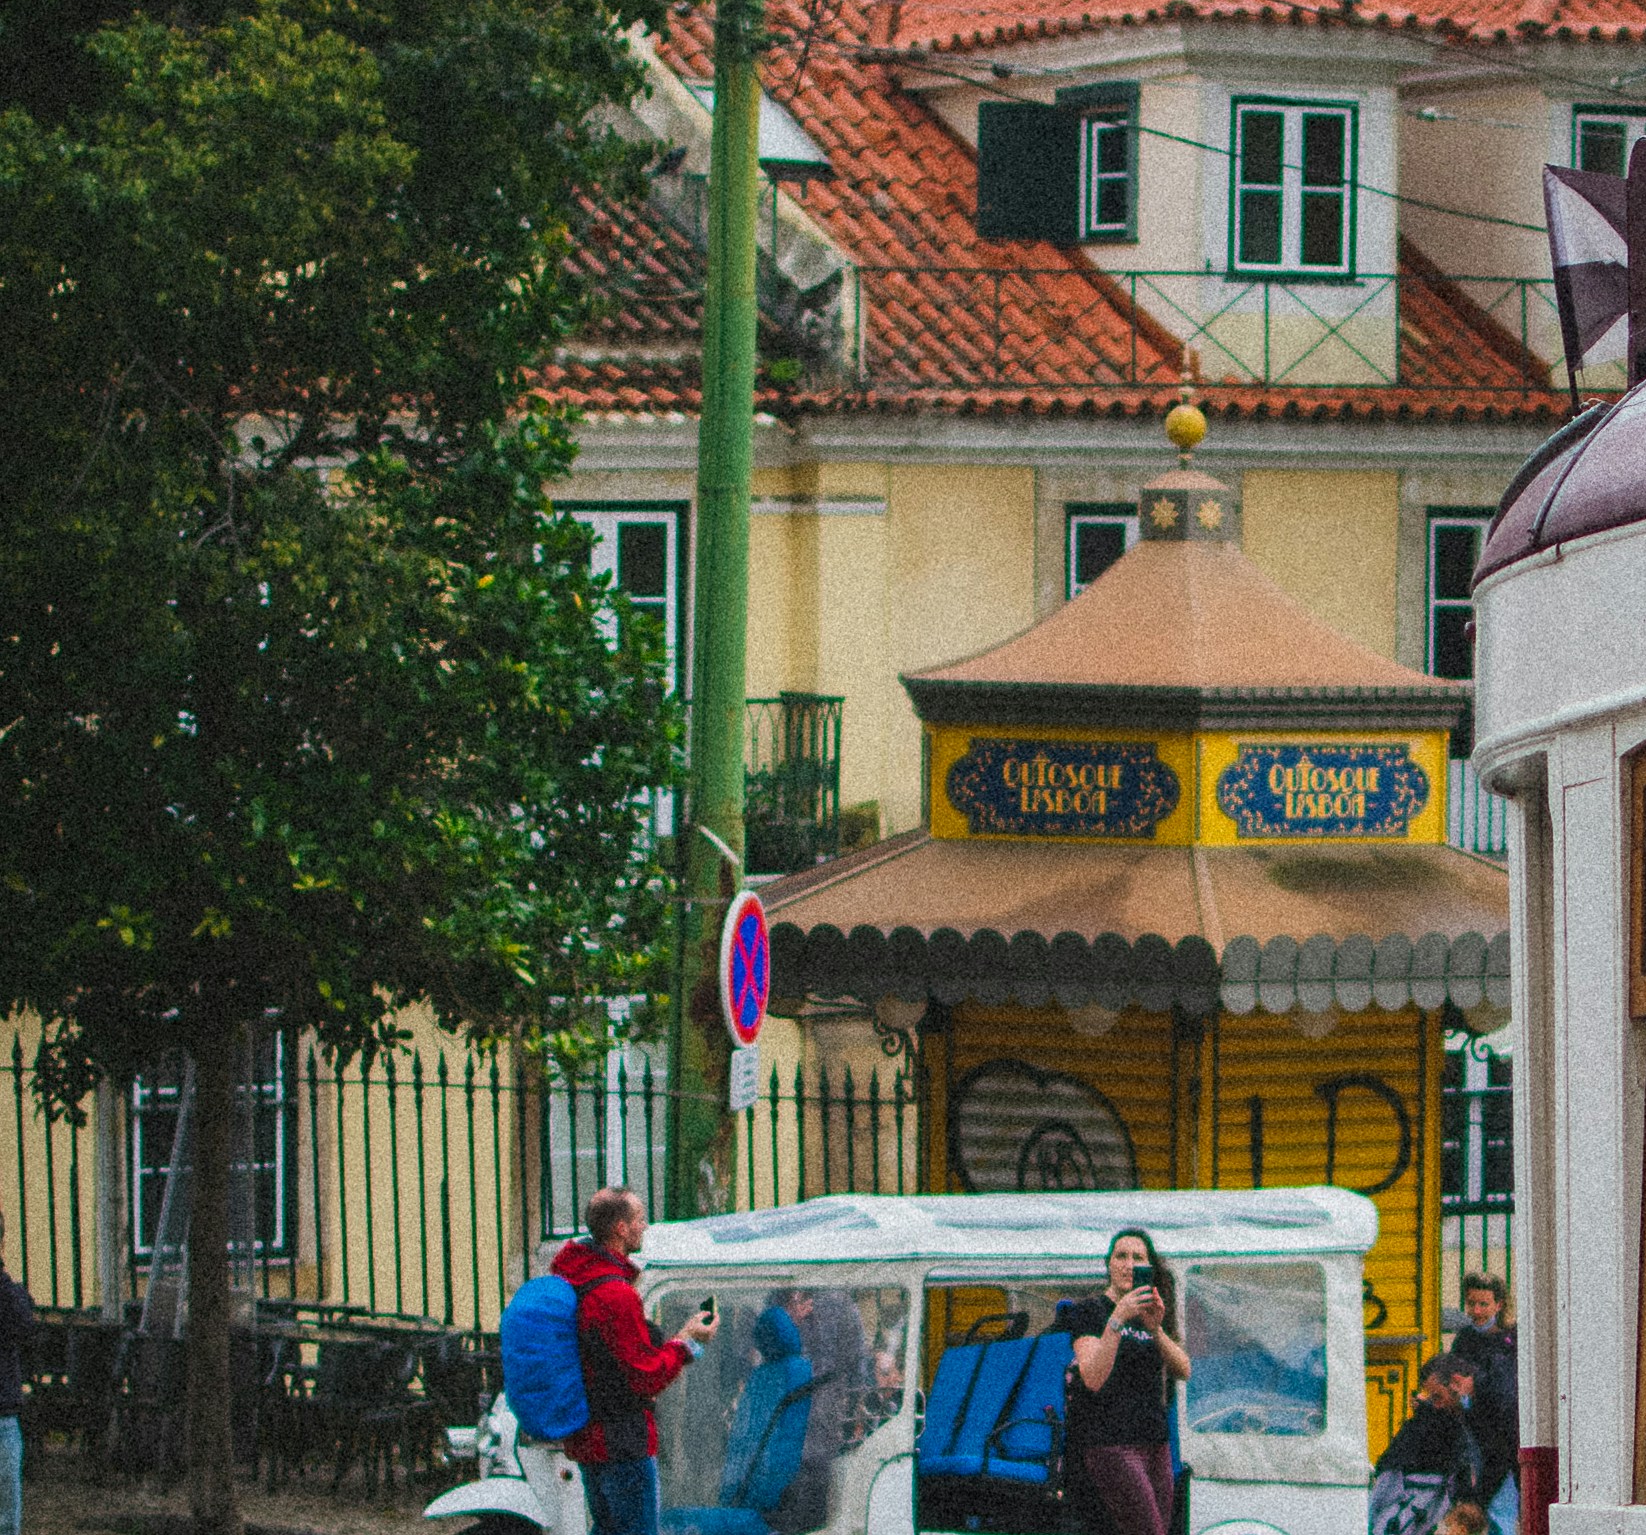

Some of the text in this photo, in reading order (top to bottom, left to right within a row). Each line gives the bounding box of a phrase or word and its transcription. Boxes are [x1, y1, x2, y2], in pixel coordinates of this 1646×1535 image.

[1003, 754, 1122, 790] QUIOSQUE
[1268, 760, 1380, 795] QUIOSQUE
[1020, 787, 1106, 814] LISBOA
[1285, 792, 1365, 818] LISBOA
